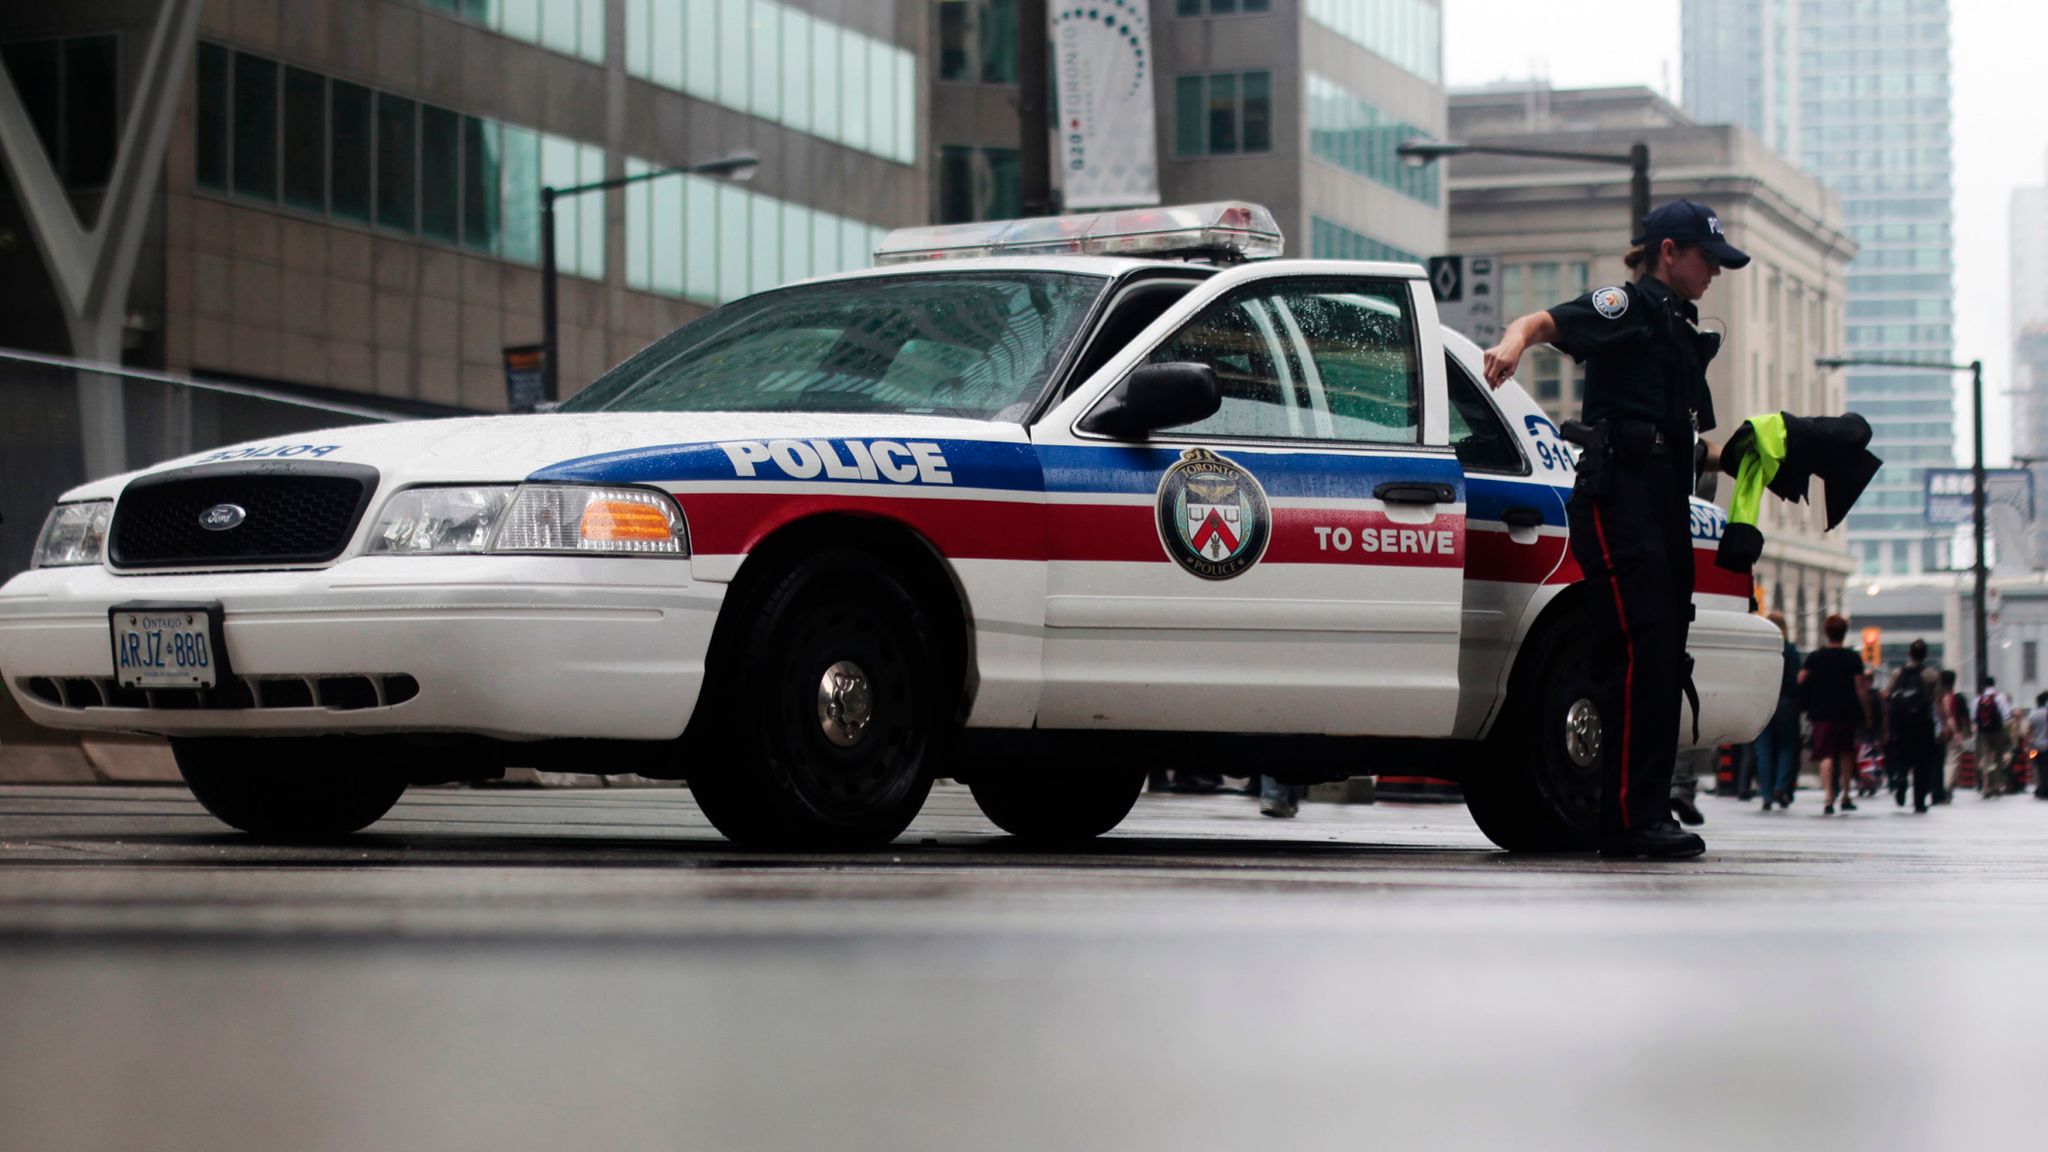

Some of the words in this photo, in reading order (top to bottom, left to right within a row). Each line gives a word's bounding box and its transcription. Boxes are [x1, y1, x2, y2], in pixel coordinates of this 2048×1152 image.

[716, 440, 954, 484] POLICE
[1181, 463, 1240, 481] TORONTO
[207, 509, 233, 524] Ford
[1314, 527, 1353, 552] TO
[1361, 528, 1455, 555] SERVE
[1194, 561, 1237, 576] POLICE
[142, 617, 182, 630] ONTARIO
